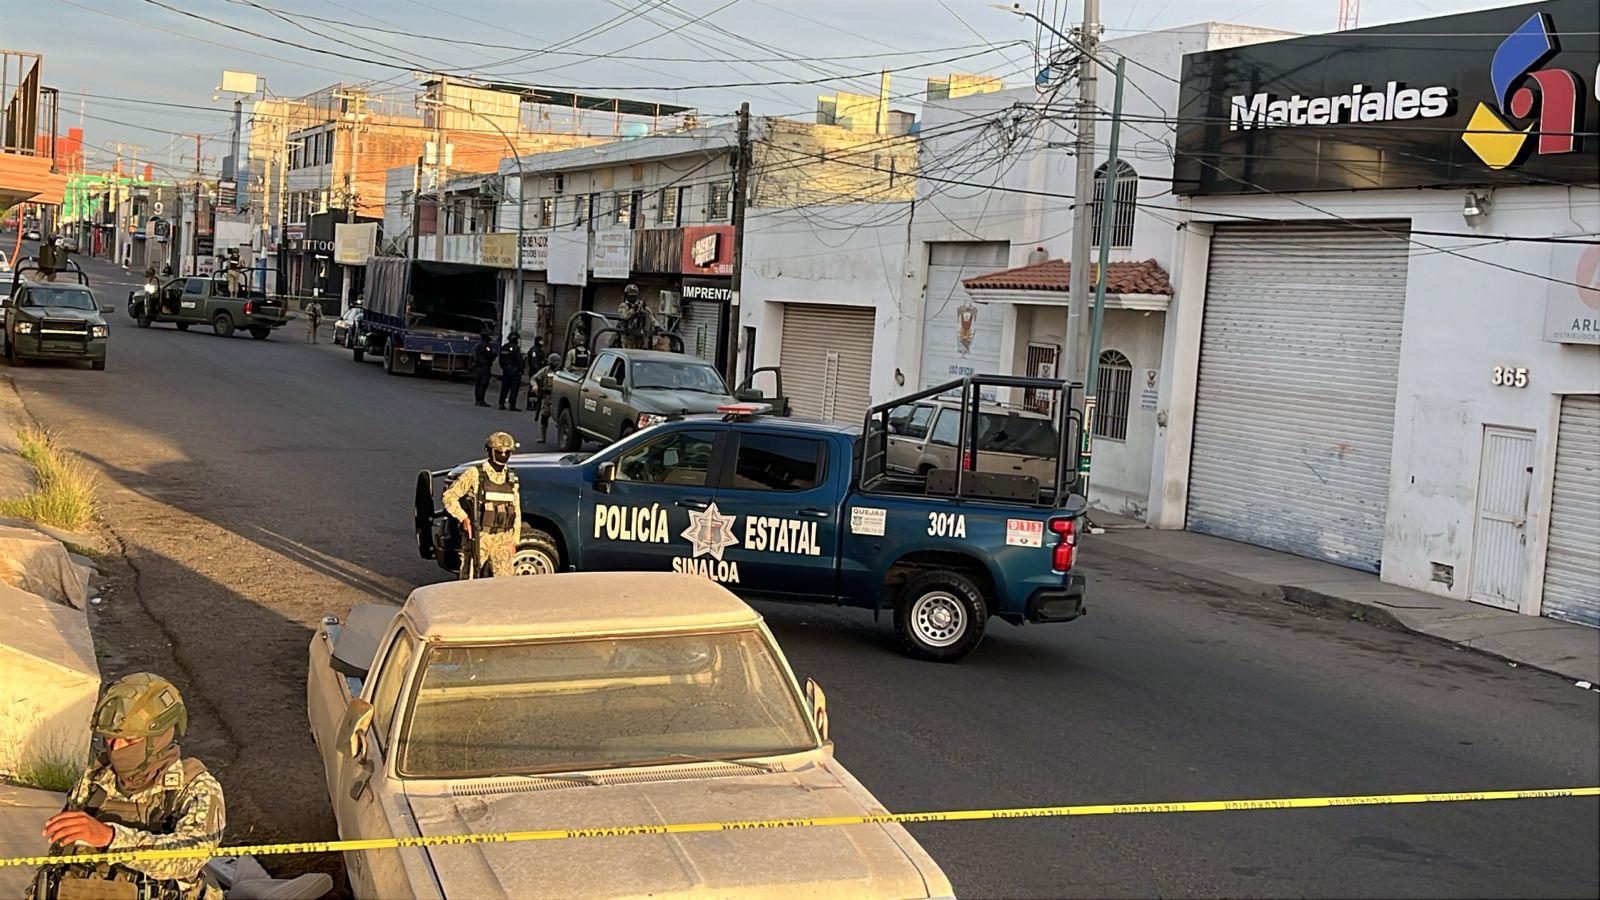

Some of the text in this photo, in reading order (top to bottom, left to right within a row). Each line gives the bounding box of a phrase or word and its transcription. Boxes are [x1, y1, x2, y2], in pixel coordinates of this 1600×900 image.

[1230, 81, 1448, 131] Materiales
[1571, 318, 1600, 332] ARL
[1492, 366, 1528, 388] 365
[853, 508, 885, 518] QUEJAS
[594, 503, 821, 556] POLICÍA ESTATAL
[927, 512, 966, 539] 301A
[1010, 521, 1040, 532] 911
[672, 556, 740, 584] SINALOA
